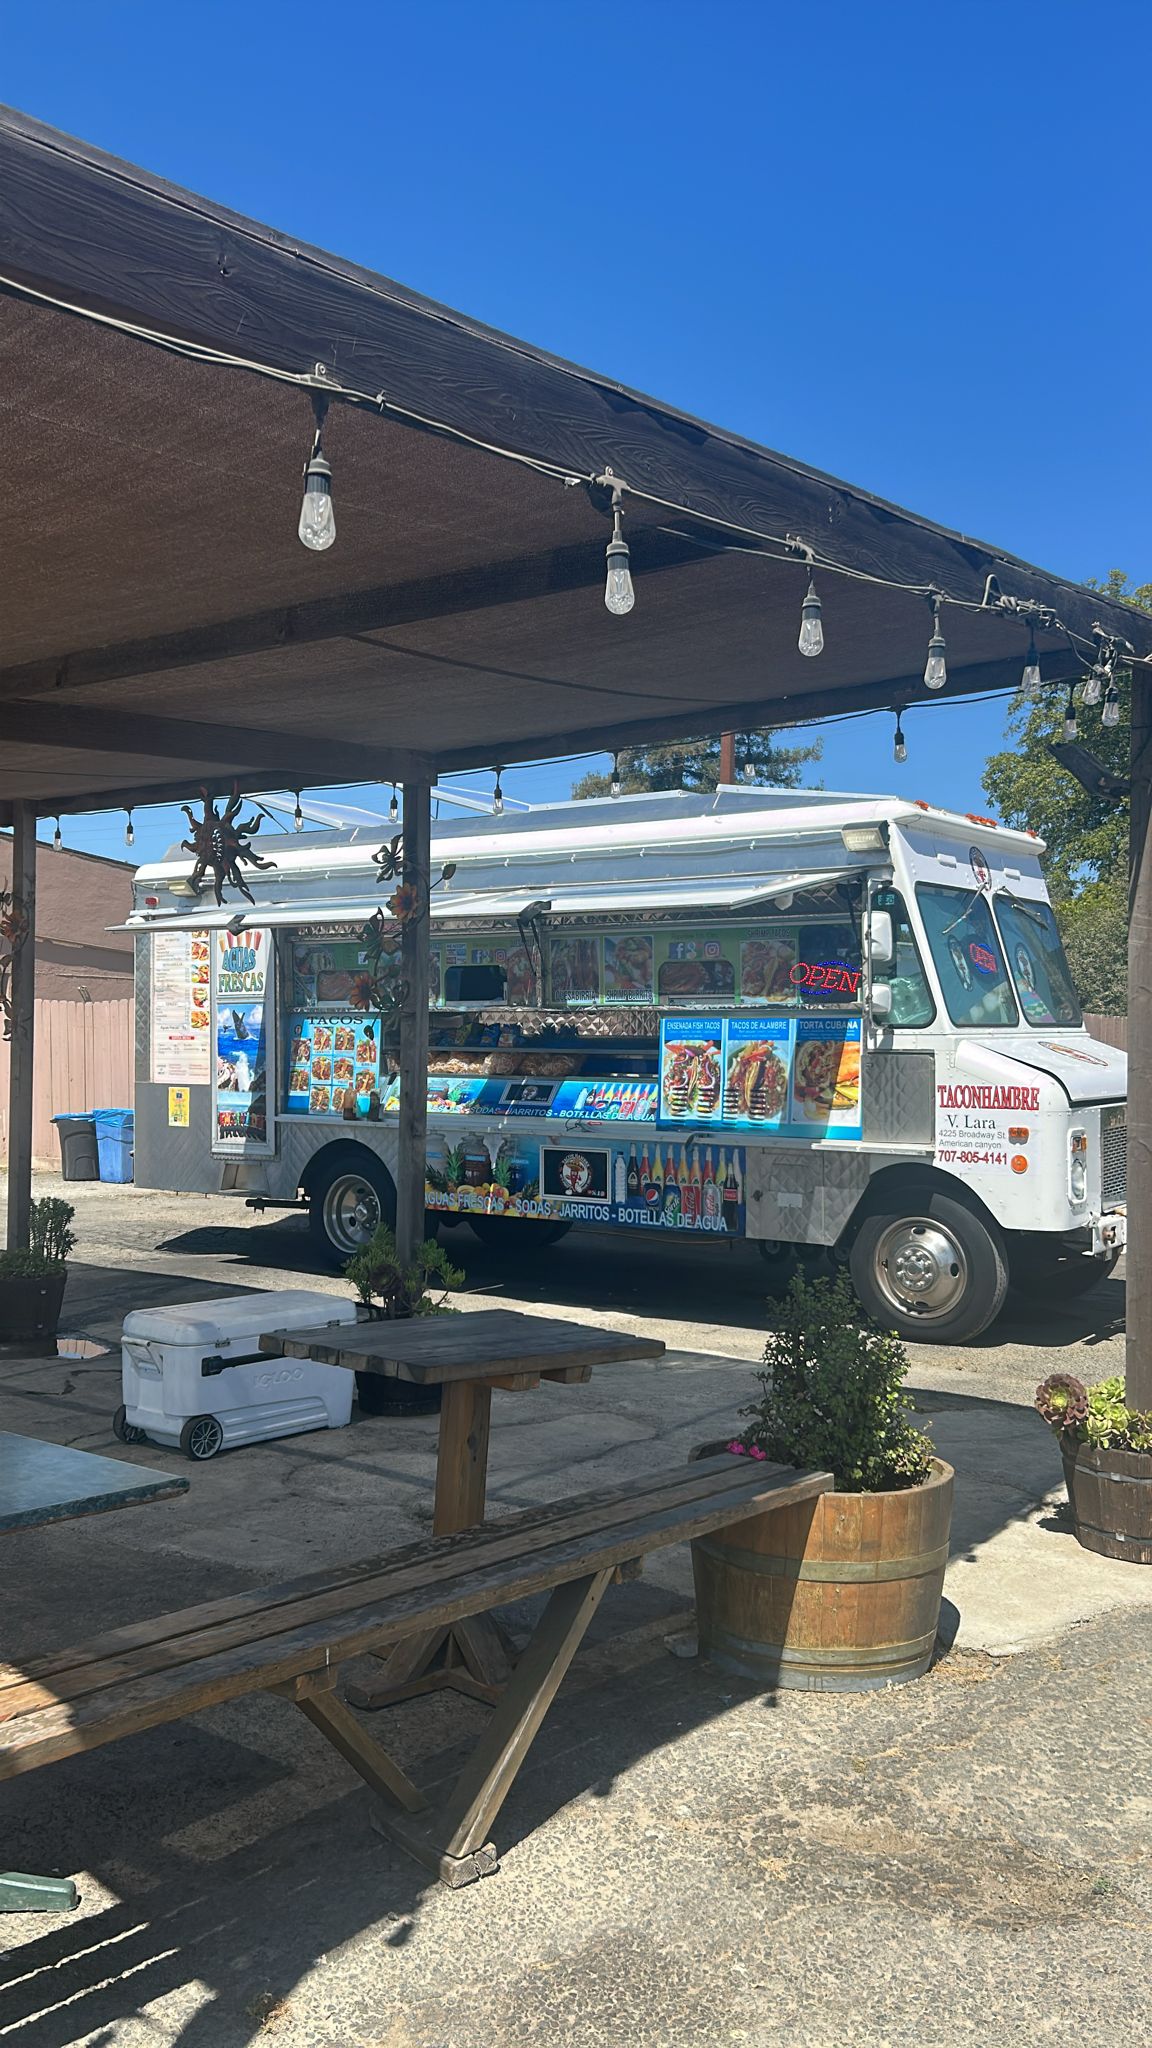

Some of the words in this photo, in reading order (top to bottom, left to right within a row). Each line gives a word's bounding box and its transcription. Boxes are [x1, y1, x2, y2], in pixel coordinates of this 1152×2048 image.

[221, 946, 256, 973] AGUAS
[218, 971, 264, 992] FRESCAS
[789, 962, 861, 992] OPEN
[306, 1015, 364, 1025] TACOS
[667, 1021, 692, 1030] ENSENADA
[692, 1021, 704, 1030] FISH
[704, 1021, 721, 1030] TACOS
[731, 1021, 750, 1030] TACOS
[750, 1021, 759, 1030] DE
[759, 1021, 787, 1030] ALAMBRE
[800, 1020, 824, 1030] TORTA
[825, 1020, 858, 1030] CUBANA
[937, 1084, 1040, 1111] TACONHAMBRE
[509, 1107, 553, 1117] JARRITOS
[947, 1114, 958, 1128] V.
[964, 1114, 996, 1129] Lara
[938, 1130, 957, 1138] 4225
[959, 1130, 995, 1141] Broadway
[938, 1139, 973, 1148] American
[974, 1141, 1002, 1150] canyon
[938, 1150, 1007, 1165] 707-805-4141
[425, 1191, 456, 1207] AGUAS
[457, 1193, 505, 1211] FRESCAS
[515, 1199, 551, 1216] SODAS
[559, 1204, 610, 1221] JARRITOS
[618, 1207, 675, 1227] BOTELLAS
[676, 1213, 693, 1229] DE
[695, 1214, 728, 1232] AGUA
[252, 1367, 304, 1391] IGLOO
